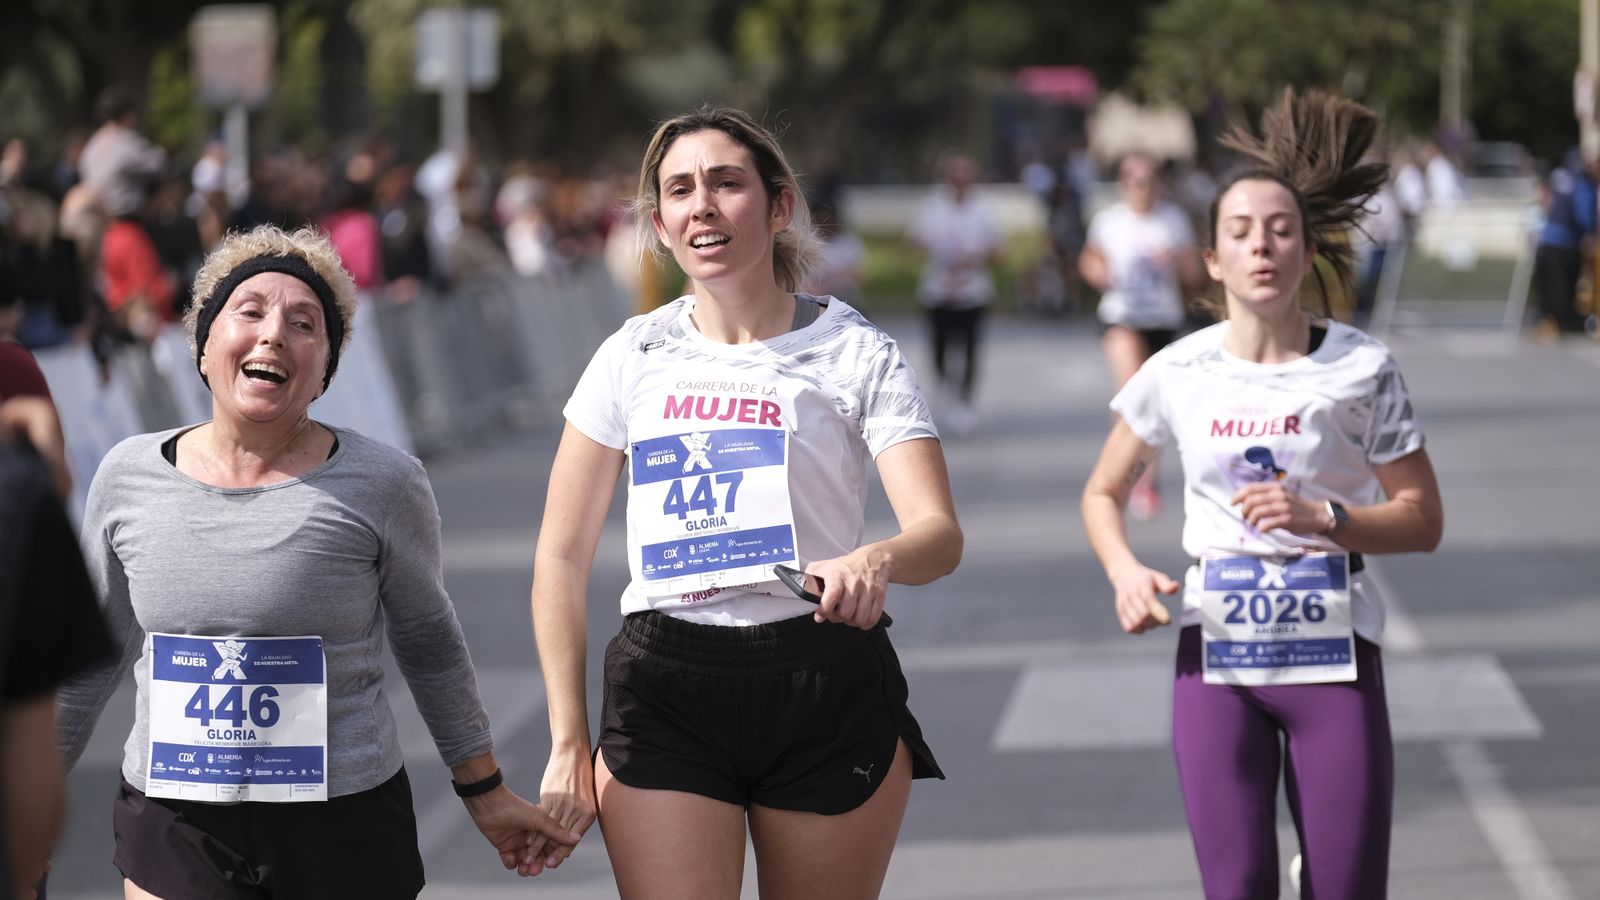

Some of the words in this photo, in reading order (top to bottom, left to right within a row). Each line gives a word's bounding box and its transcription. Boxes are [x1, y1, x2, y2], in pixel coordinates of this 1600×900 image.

[676, 380, 736, 392] CARRERA
[739, 382, 758, 394] DE
[761, 385, 778, 397] LA
[663, 395, 782, 427] MUJER
[1211, 415, 1301, 437] MUJER
[646, 453, 677, 467] MUJER
[662, 471, 743, 520] 447
[685, 515, 728, 531] GLORIA
[1222, 593, 1327, 625] 2026
[172, 655, 208, 667] MUJER
[184, 684, 280, 728] 446
[207, 728, 257, 741] GLORIA
[178, 752, 197, 763] CDX
[217, 753, 243, 761] ALMERÍA
